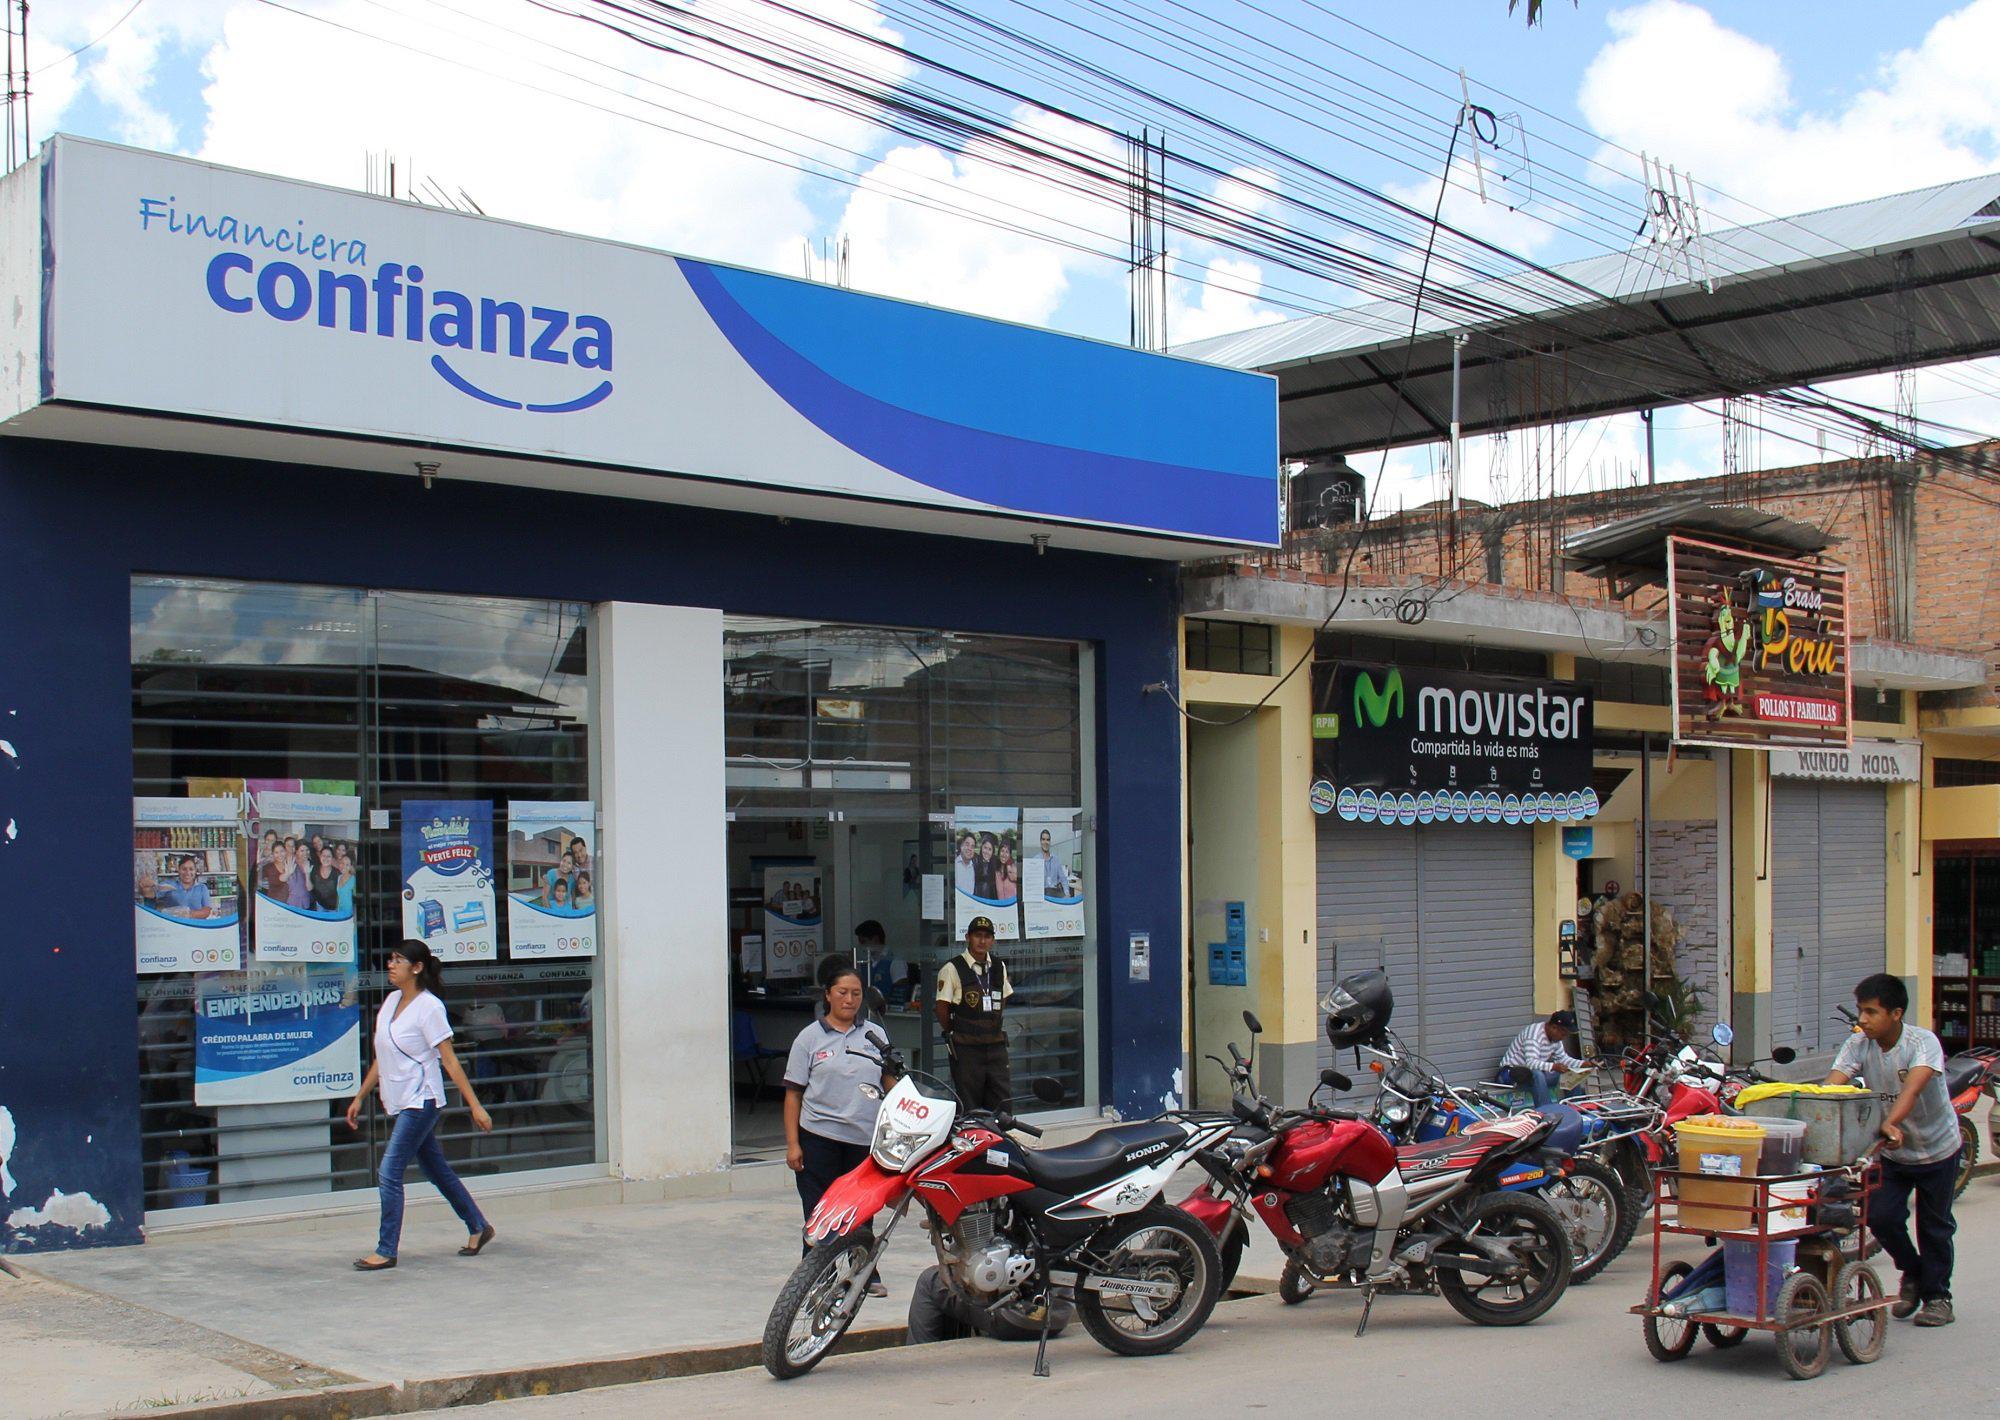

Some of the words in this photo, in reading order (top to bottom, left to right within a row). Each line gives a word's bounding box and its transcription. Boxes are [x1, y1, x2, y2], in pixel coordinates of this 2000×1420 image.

[139, 197, 366, 266] Financiera
[206, 253, 613, 371] confianza
[1783, 577, 1823, 611] Brasa
[1418, 687, 1585, 739] movistar
[1759, 698, 1789, 719] POLLOS
[1790, 702, 1796, 718] Y
[1796, 702, 1837, 722] PARRILLAS
[1316, 717, 1335, 729] RPM
[1411, 738, 1471, 759] Compartida
[1473, 742, 1482, 757] la
[1484, 742, 1505, 758] vida
[1506, 746, 1518, 758] es
[1519, 744, 1539, 759] más
[1799, 751, 1849, 773] MUNDO
[1862, 754, 1900, 775] MODA
[427, 851, 451, 862] VERTE
[452, 848, 472, 858] FELIZ
[263, 944, 298, 952] confianza
[515, 943, 546, 951] confianza
[140, 954, 177, 963] confianza
[475, 973, 524, 982] CONFIANZA
[539, 969, 586, 978] CONFIANZA
[202, 1034, 237, 1044] CRÉDITO
[237, 1033, 274, 1042] PALABRA
[275, 1032, 286, 1040] DE
[286, 1031, 313, 1040] MUJER
[293, 1071, 354, 1085] confianza
[896, 1097, 929, 1120] NEO
[1125, 1141, 1169, 1162] HONDA
[1502, 1174, 1520, 1184] YAMAHA
[1527, 1170, 1544, 1180] 200
[1100, 1280, 1154, 1294] BRIDGESTONE
